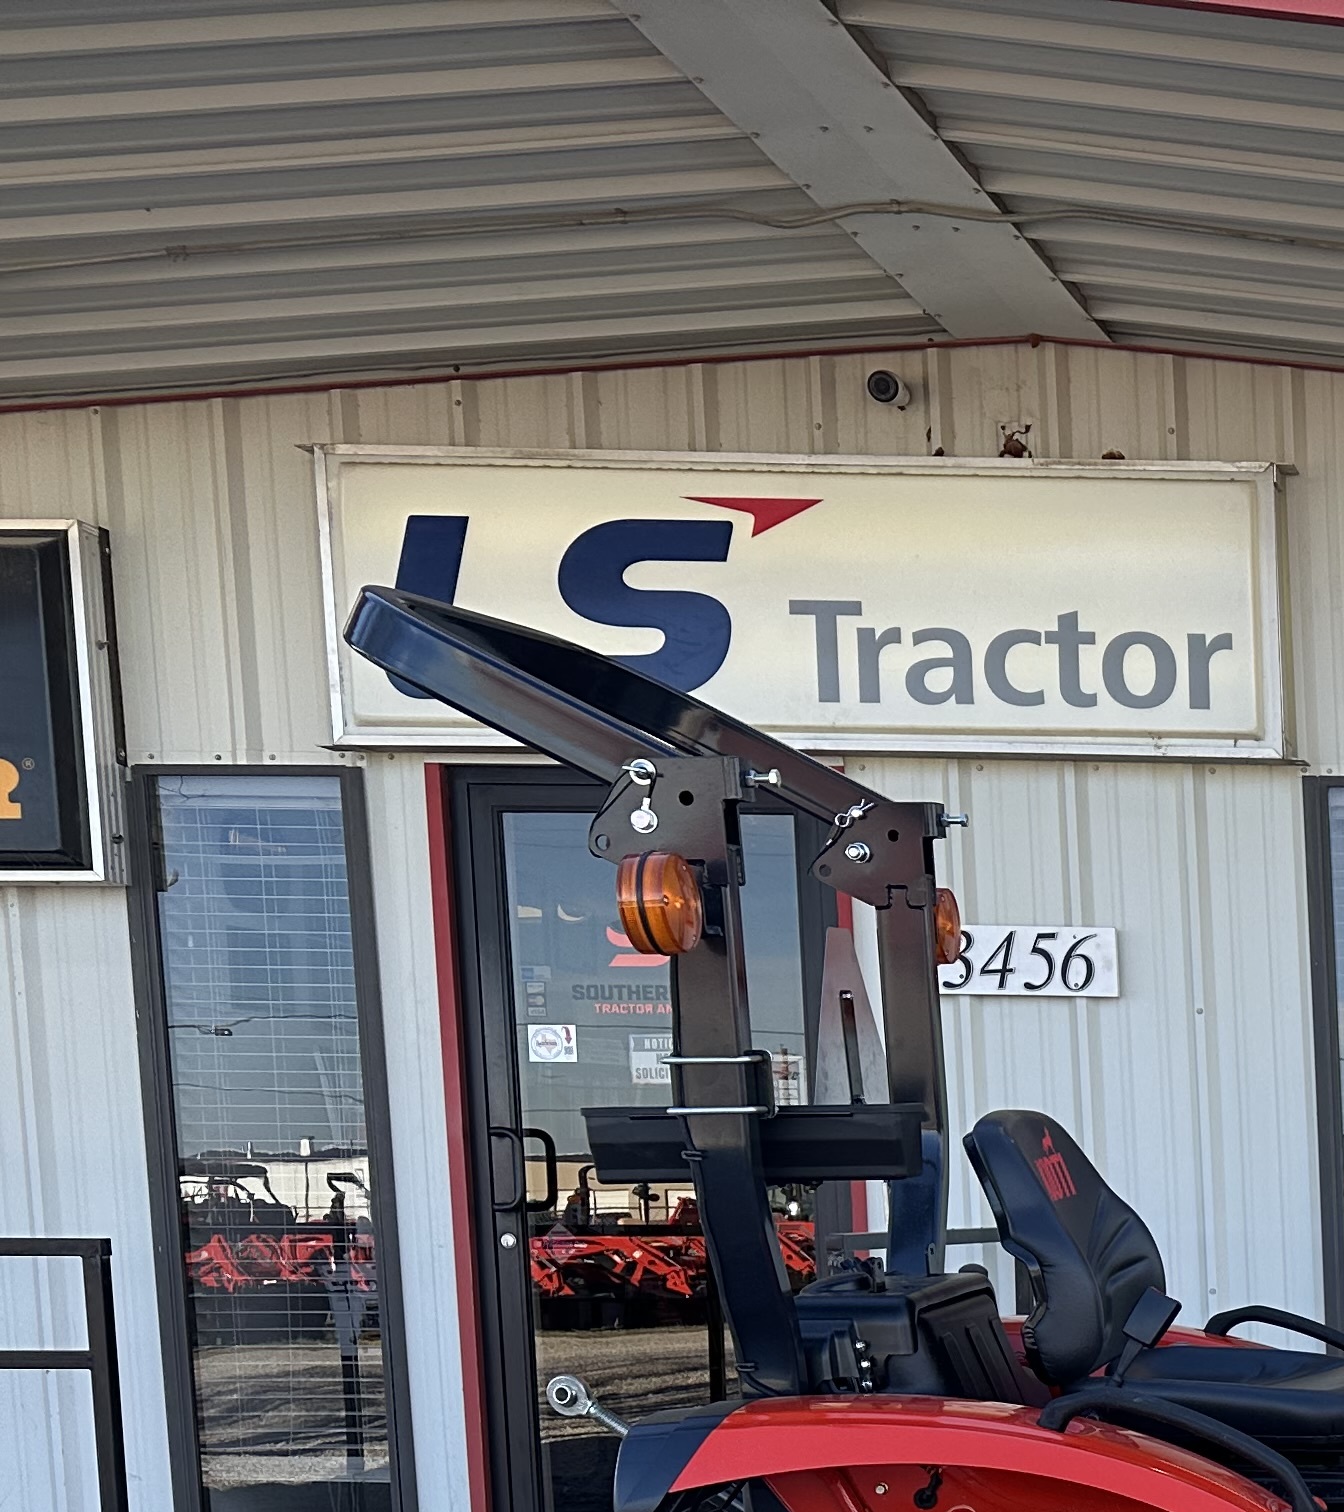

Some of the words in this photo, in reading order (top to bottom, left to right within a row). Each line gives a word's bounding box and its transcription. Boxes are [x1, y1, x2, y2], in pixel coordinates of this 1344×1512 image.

[789, 600, 1233, 710] Tractor
[942, 930, 1097, 991] 3456
[572, 984, 669, 1000] SOUTHER
[594, 1003, 653, 1014] TRACTOR
[656, 1003, 672, 1014] AN
[644, 1038, 673, 1050] NOTIC
